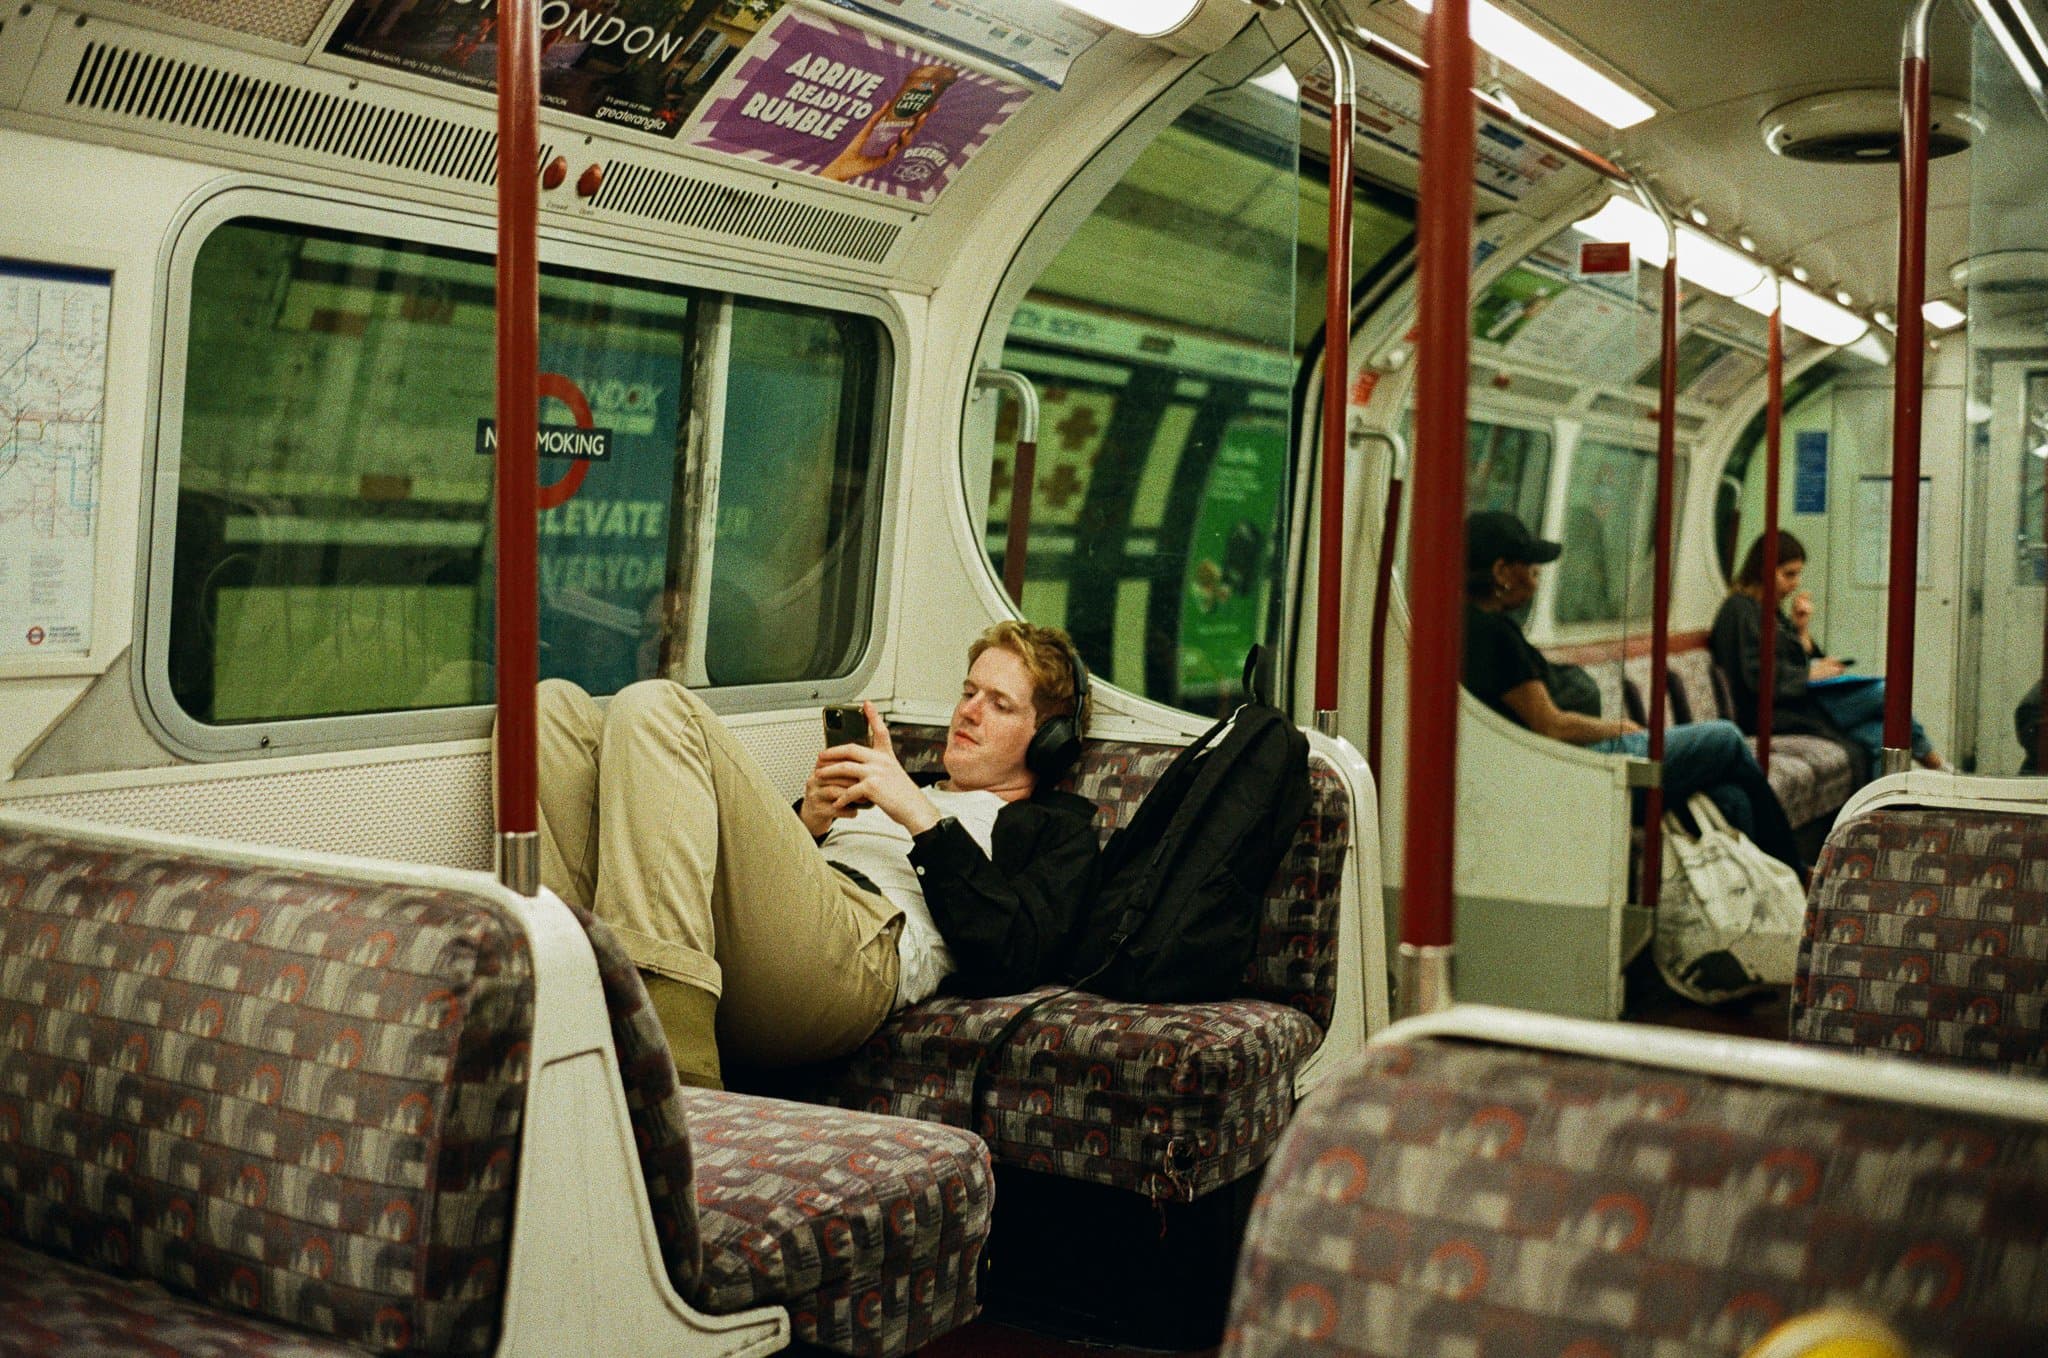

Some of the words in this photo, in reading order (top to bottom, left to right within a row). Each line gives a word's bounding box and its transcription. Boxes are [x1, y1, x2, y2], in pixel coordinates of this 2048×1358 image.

[539, 1, 684, 63] ONDON
[785, 52, 885, 99] ARRIVE
[595, 104, 667, 131] greateranglia
[740, 91, 849, 141] RUMBLE
[785, 81, 852, 113] READY
[845, 99, 873, 120] TO
[536, 431, 605, 455] MOKING
[538, 497, 666, 537] LEVATE
